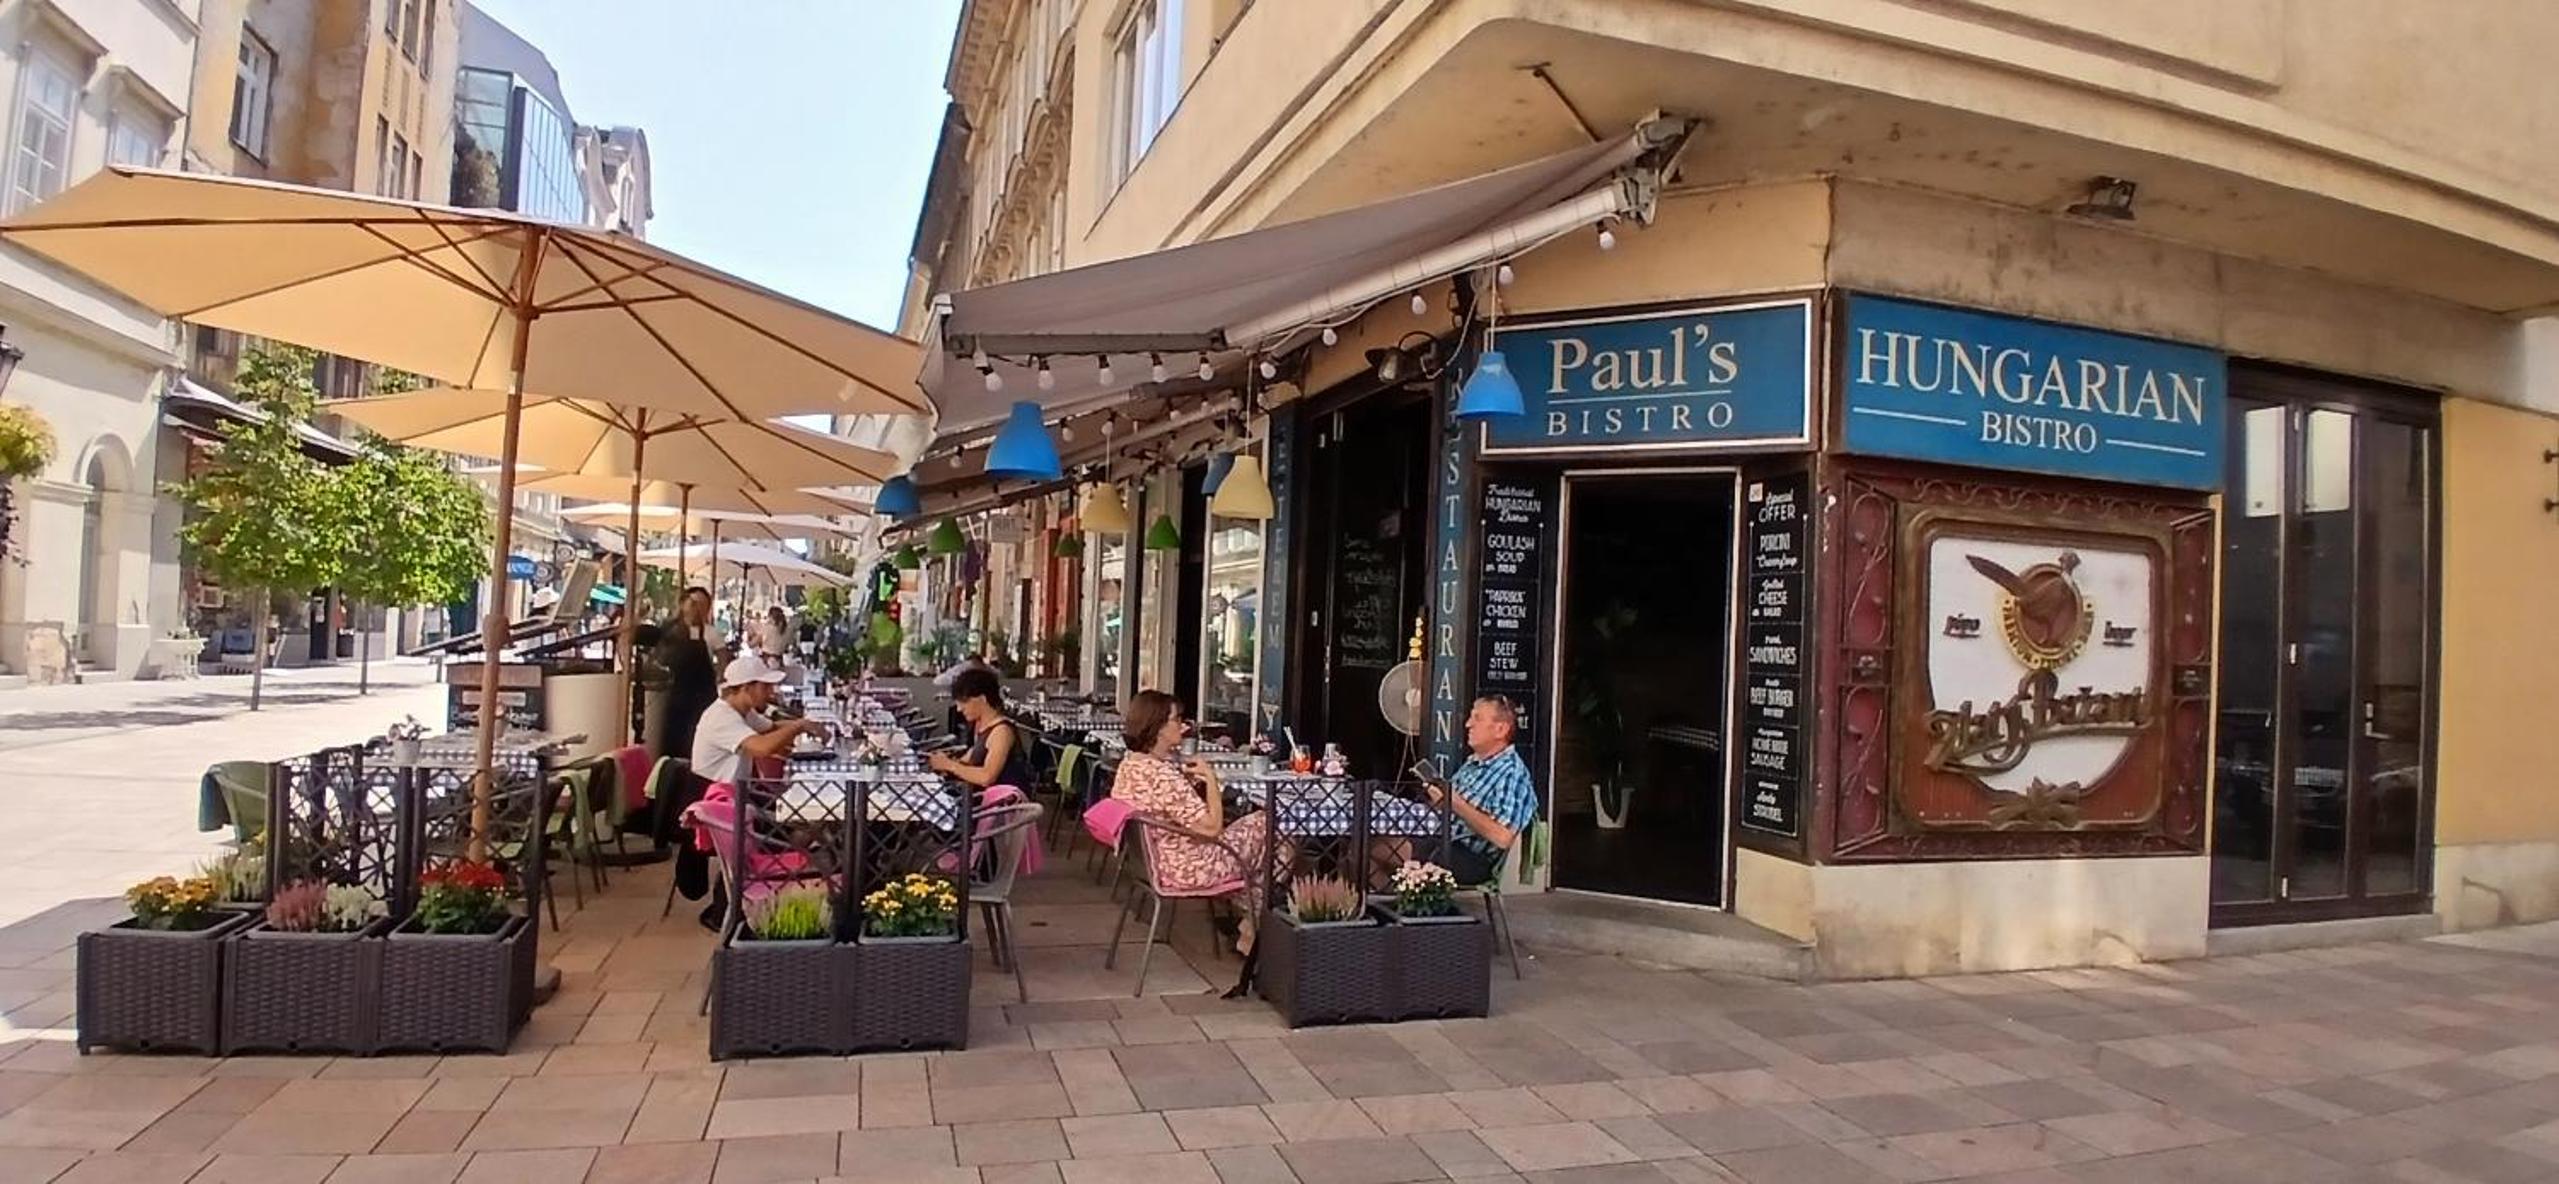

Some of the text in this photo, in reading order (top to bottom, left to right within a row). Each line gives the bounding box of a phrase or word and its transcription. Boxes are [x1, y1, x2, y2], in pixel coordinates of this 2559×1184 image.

[1547, 323, 1739, 395] Paul's
[1856, 327, 2206, 427] HUNGARIAN
[1547, 402, 1734, 437] BISTRO
[1980, 411, 2098, 454] BISTRO
[1485, 496, 1542, 513] HUNGARIAN
[1758, 503, 1796, 523] OFFER
[1487, 533, 1535, 550] GOULASH
[1495, 550, 1525, 563] SOUP
[1758, 591, 1788, 606] CHEESE
[1485, 604, 1526, 618] CHICKEN
[1493, 641, 1518, 656] BEEF
[1749, 646, 1797, 665] SANDWICHES
[1488, 657, 1519, 670] STEW
[1750, 752, 1786, 770] SAUSAGE
